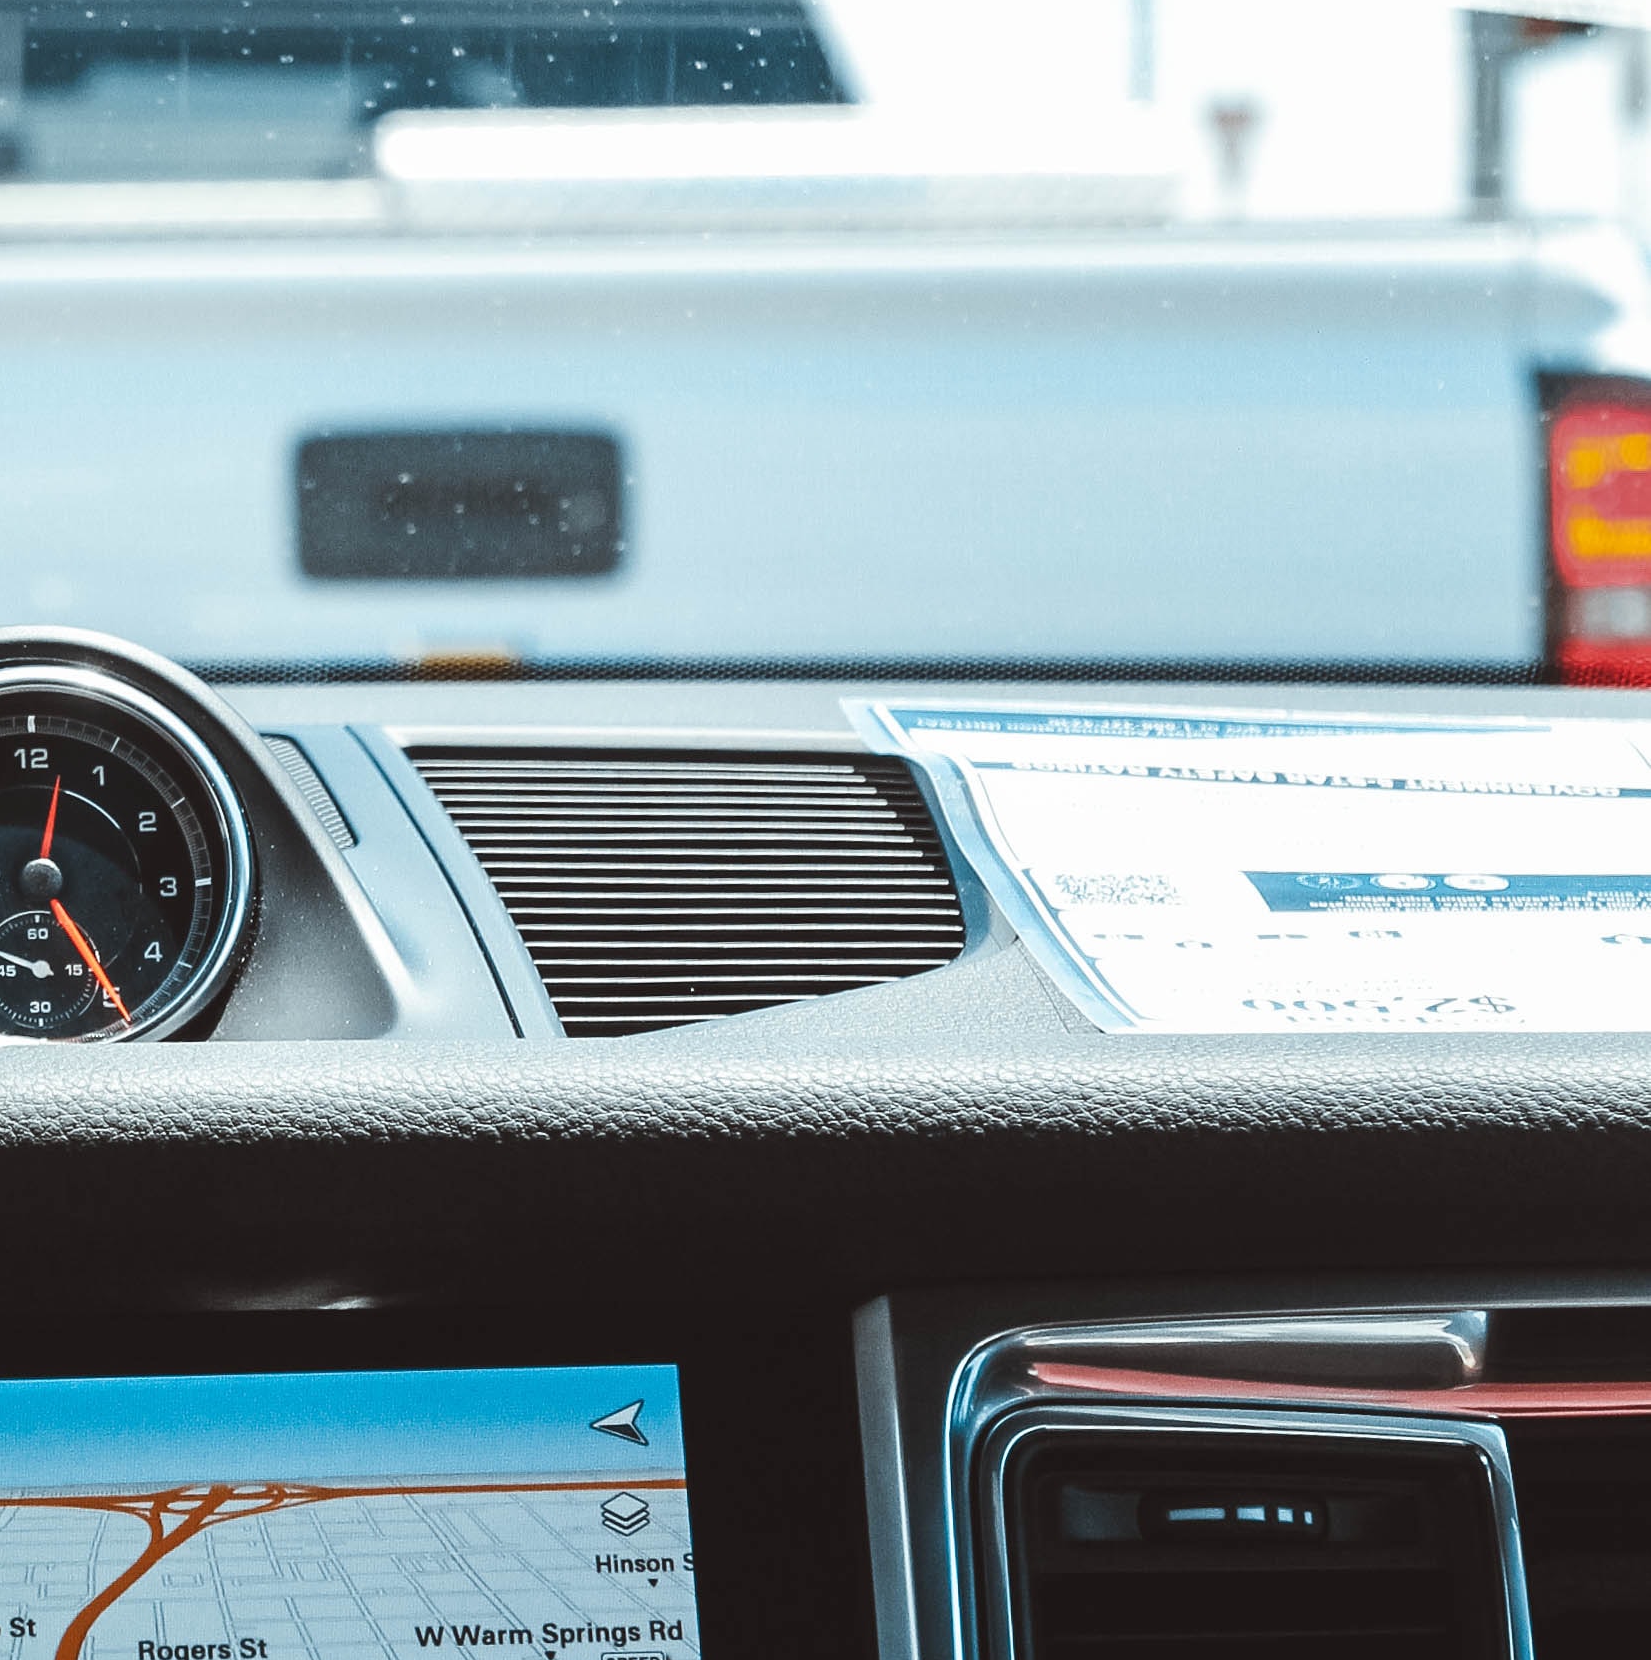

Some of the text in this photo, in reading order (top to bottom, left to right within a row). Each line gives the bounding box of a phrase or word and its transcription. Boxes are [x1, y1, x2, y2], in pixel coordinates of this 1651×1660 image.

[15, 748, 48, 769] 12
[93, 766, 105, 785] 1
[139, 812, 156, 832] 2
[160, 877, 177, 896] 3
[27, 929, 48, 940] 60
[144, 942, 163, 961] 4
[65, 964, 82, 976] 15
[30, 1001, 50, 1013] 30
[596, 1554, 674, 1573] Hinson
[9, 1617, 36, 1639] St
[415, 1620, 682, 1649] W Warm Springs Rd
[239, 1639, 267, 1660] St
